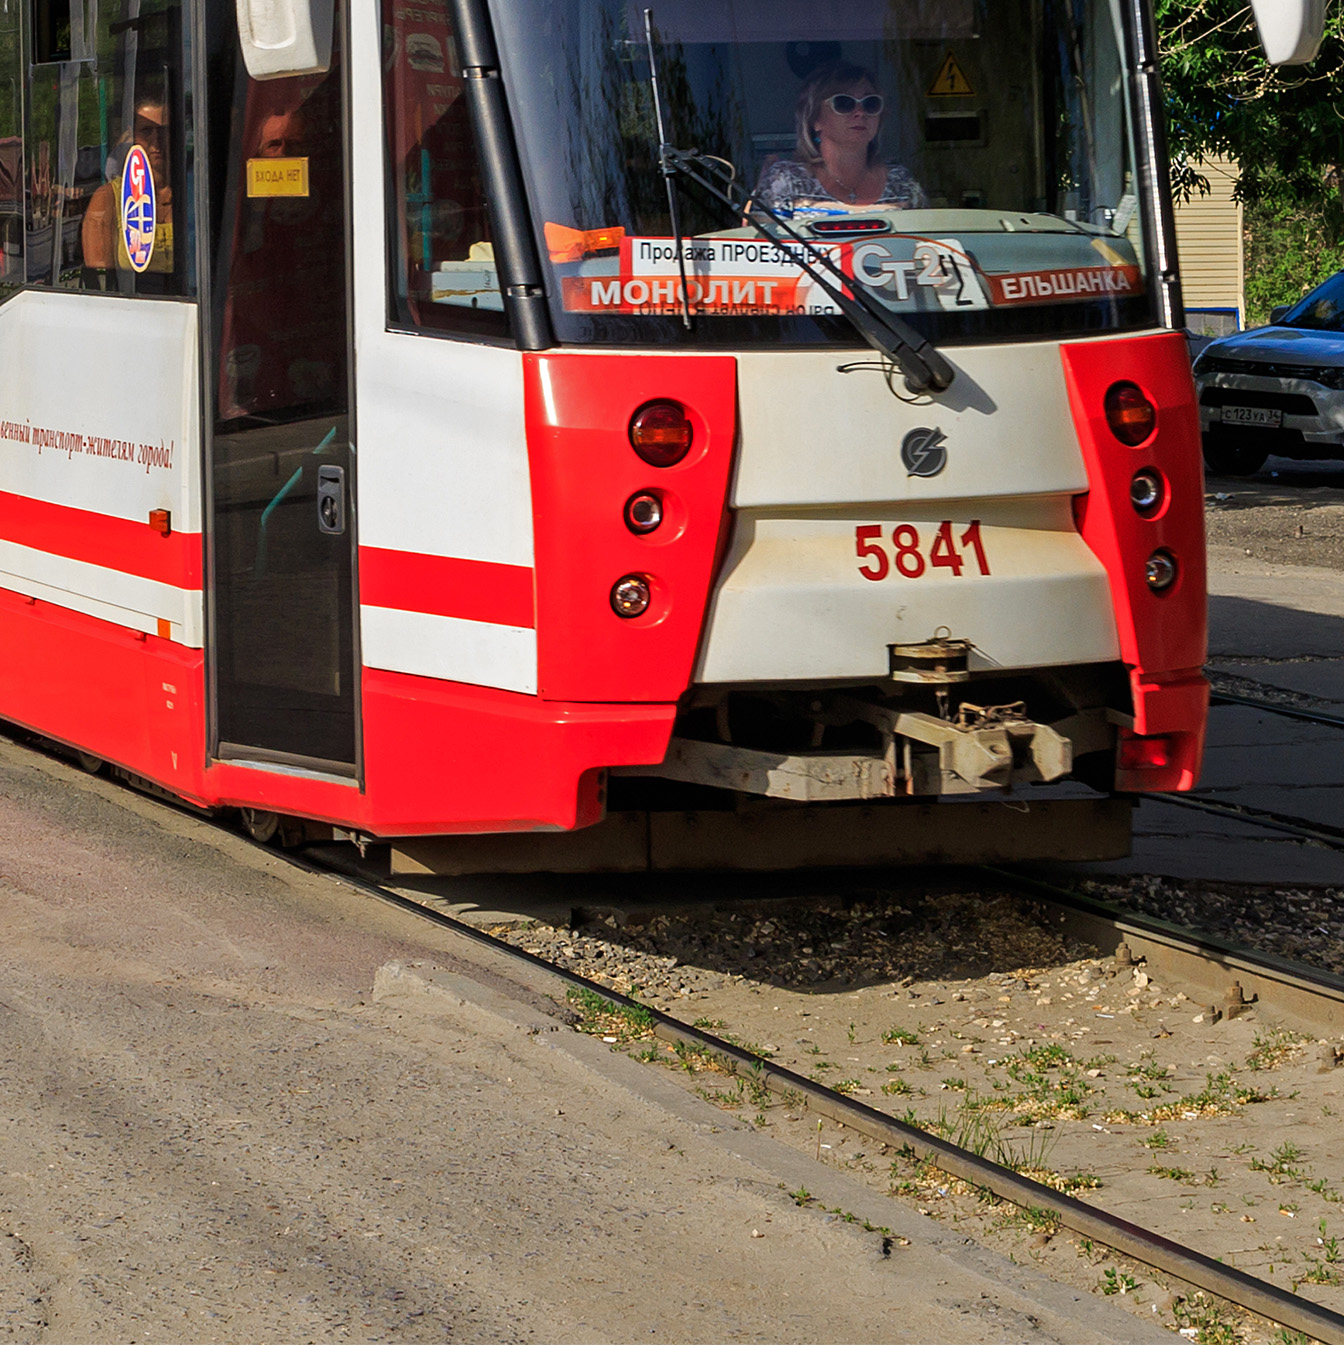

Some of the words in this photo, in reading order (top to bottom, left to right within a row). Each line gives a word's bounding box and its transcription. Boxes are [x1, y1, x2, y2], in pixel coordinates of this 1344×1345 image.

[256, 170, 283, 183] ВХОДА
[287, 168, 301, 182] НЕТ
[640, 242, 716, 264] Продажа
[853, 243, 944, 301] СТ2
[1001, 269, 1132, 300] ЕЛЬШАНКА
[591, 280, 780, 306] МОНОЛИТ
[137, 437, 175, 475] города!
[855, 519, 992, 582] 5841
